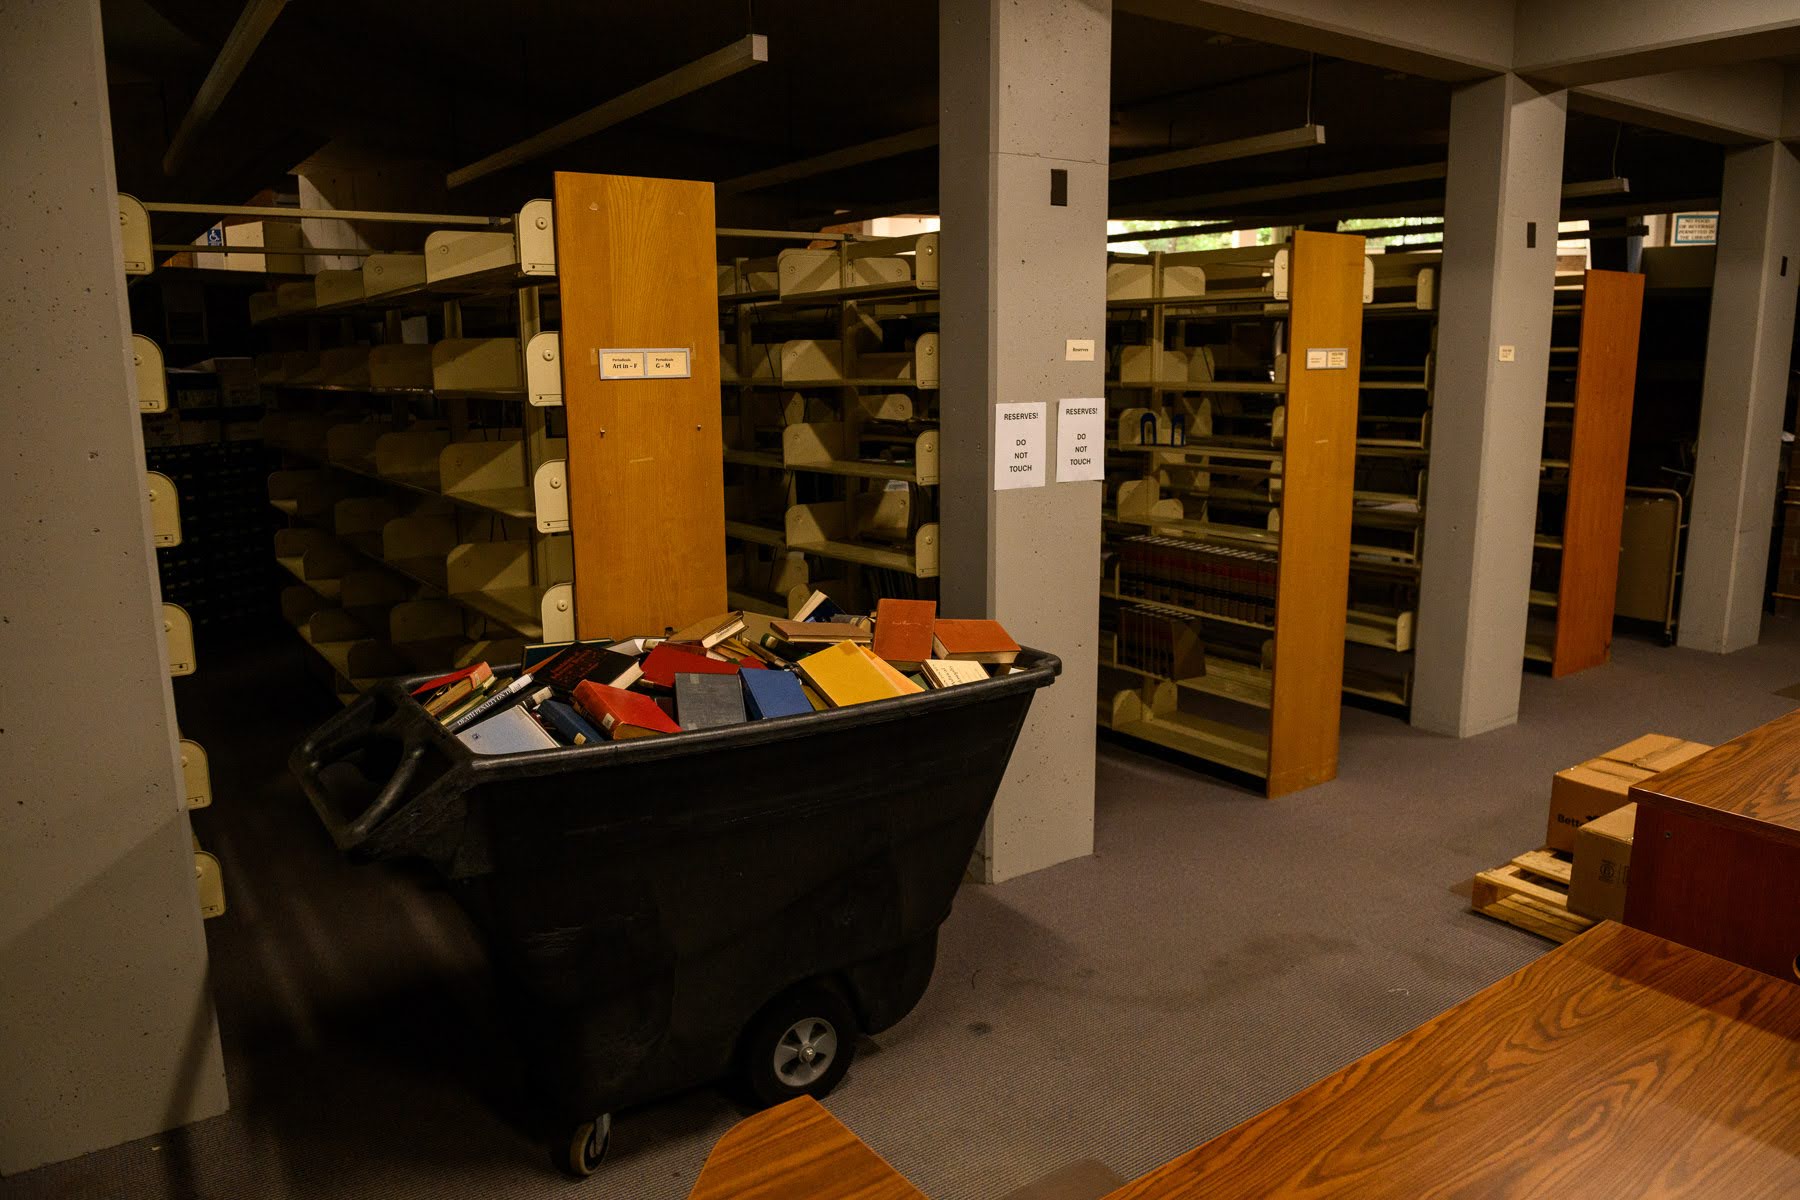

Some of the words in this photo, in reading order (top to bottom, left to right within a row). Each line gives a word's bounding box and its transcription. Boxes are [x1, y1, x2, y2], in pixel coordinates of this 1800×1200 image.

[1004, 412, 1039, 420] RESERVES!
[1076, 433, 1087, 441] DO
[1016, 439, 1027, 447] DO
[1074, 445, 1088, 454] NOT
[1014, 451, 1028, 460] NOT
[1070, 457, 1091, 466] TOUCH
[1009, 464, 1032, 473] TOUCH
[456, 711, 477, 726] DEATH
[474, 698, 498, 716] PENALTY
